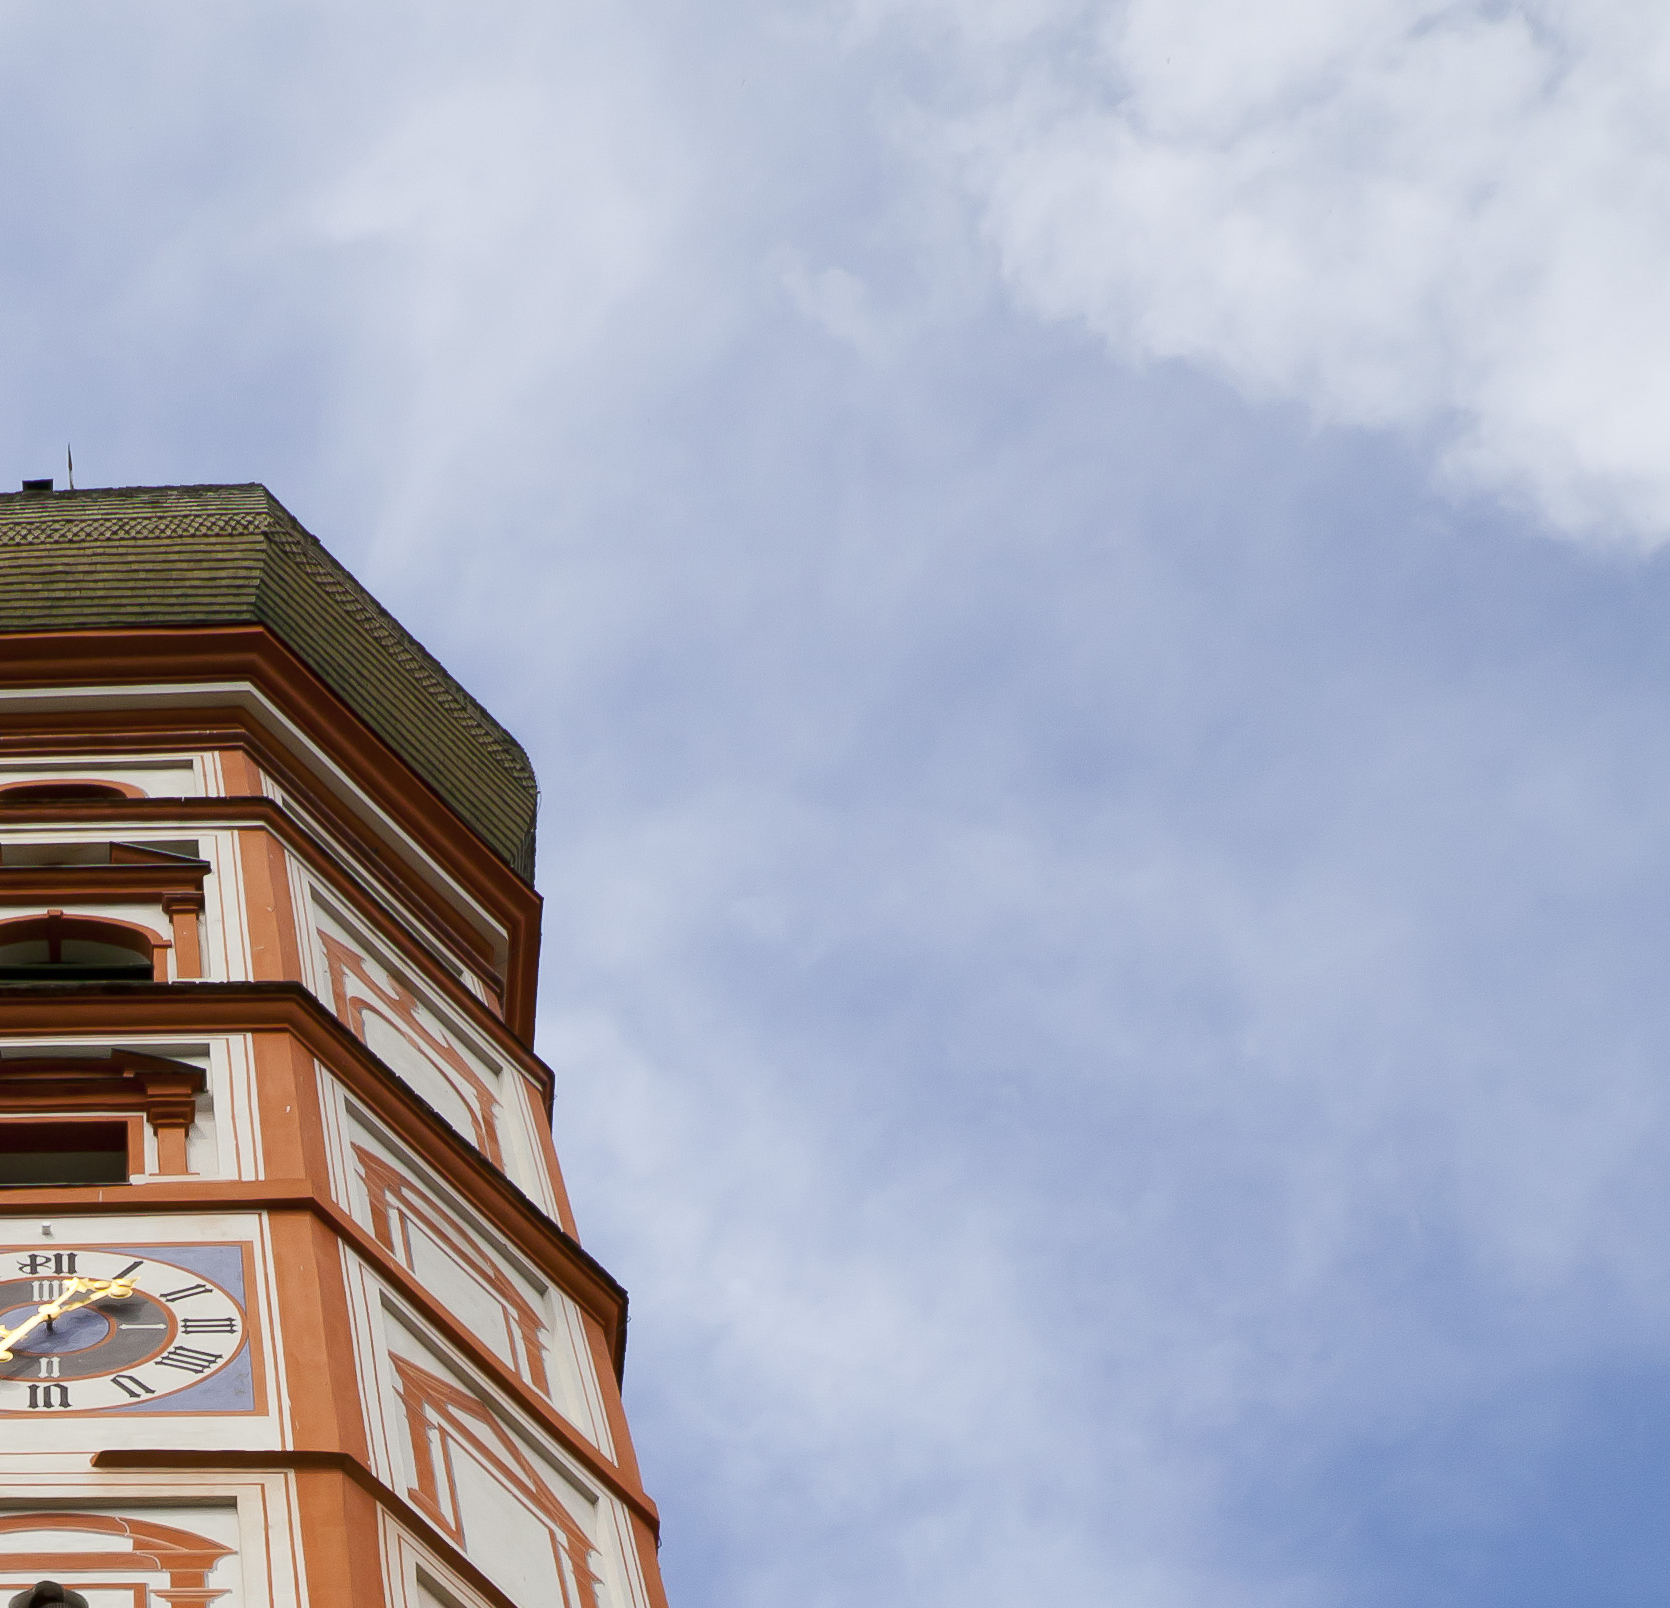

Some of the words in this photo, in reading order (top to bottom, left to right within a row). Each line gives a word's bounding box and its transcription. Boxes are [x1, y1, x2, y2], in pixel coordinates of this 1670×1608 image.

[16, 1253, 77, 1275] XII
[159, 1283, 214, 1302] II
[180, 1317, 238, 1335] III
